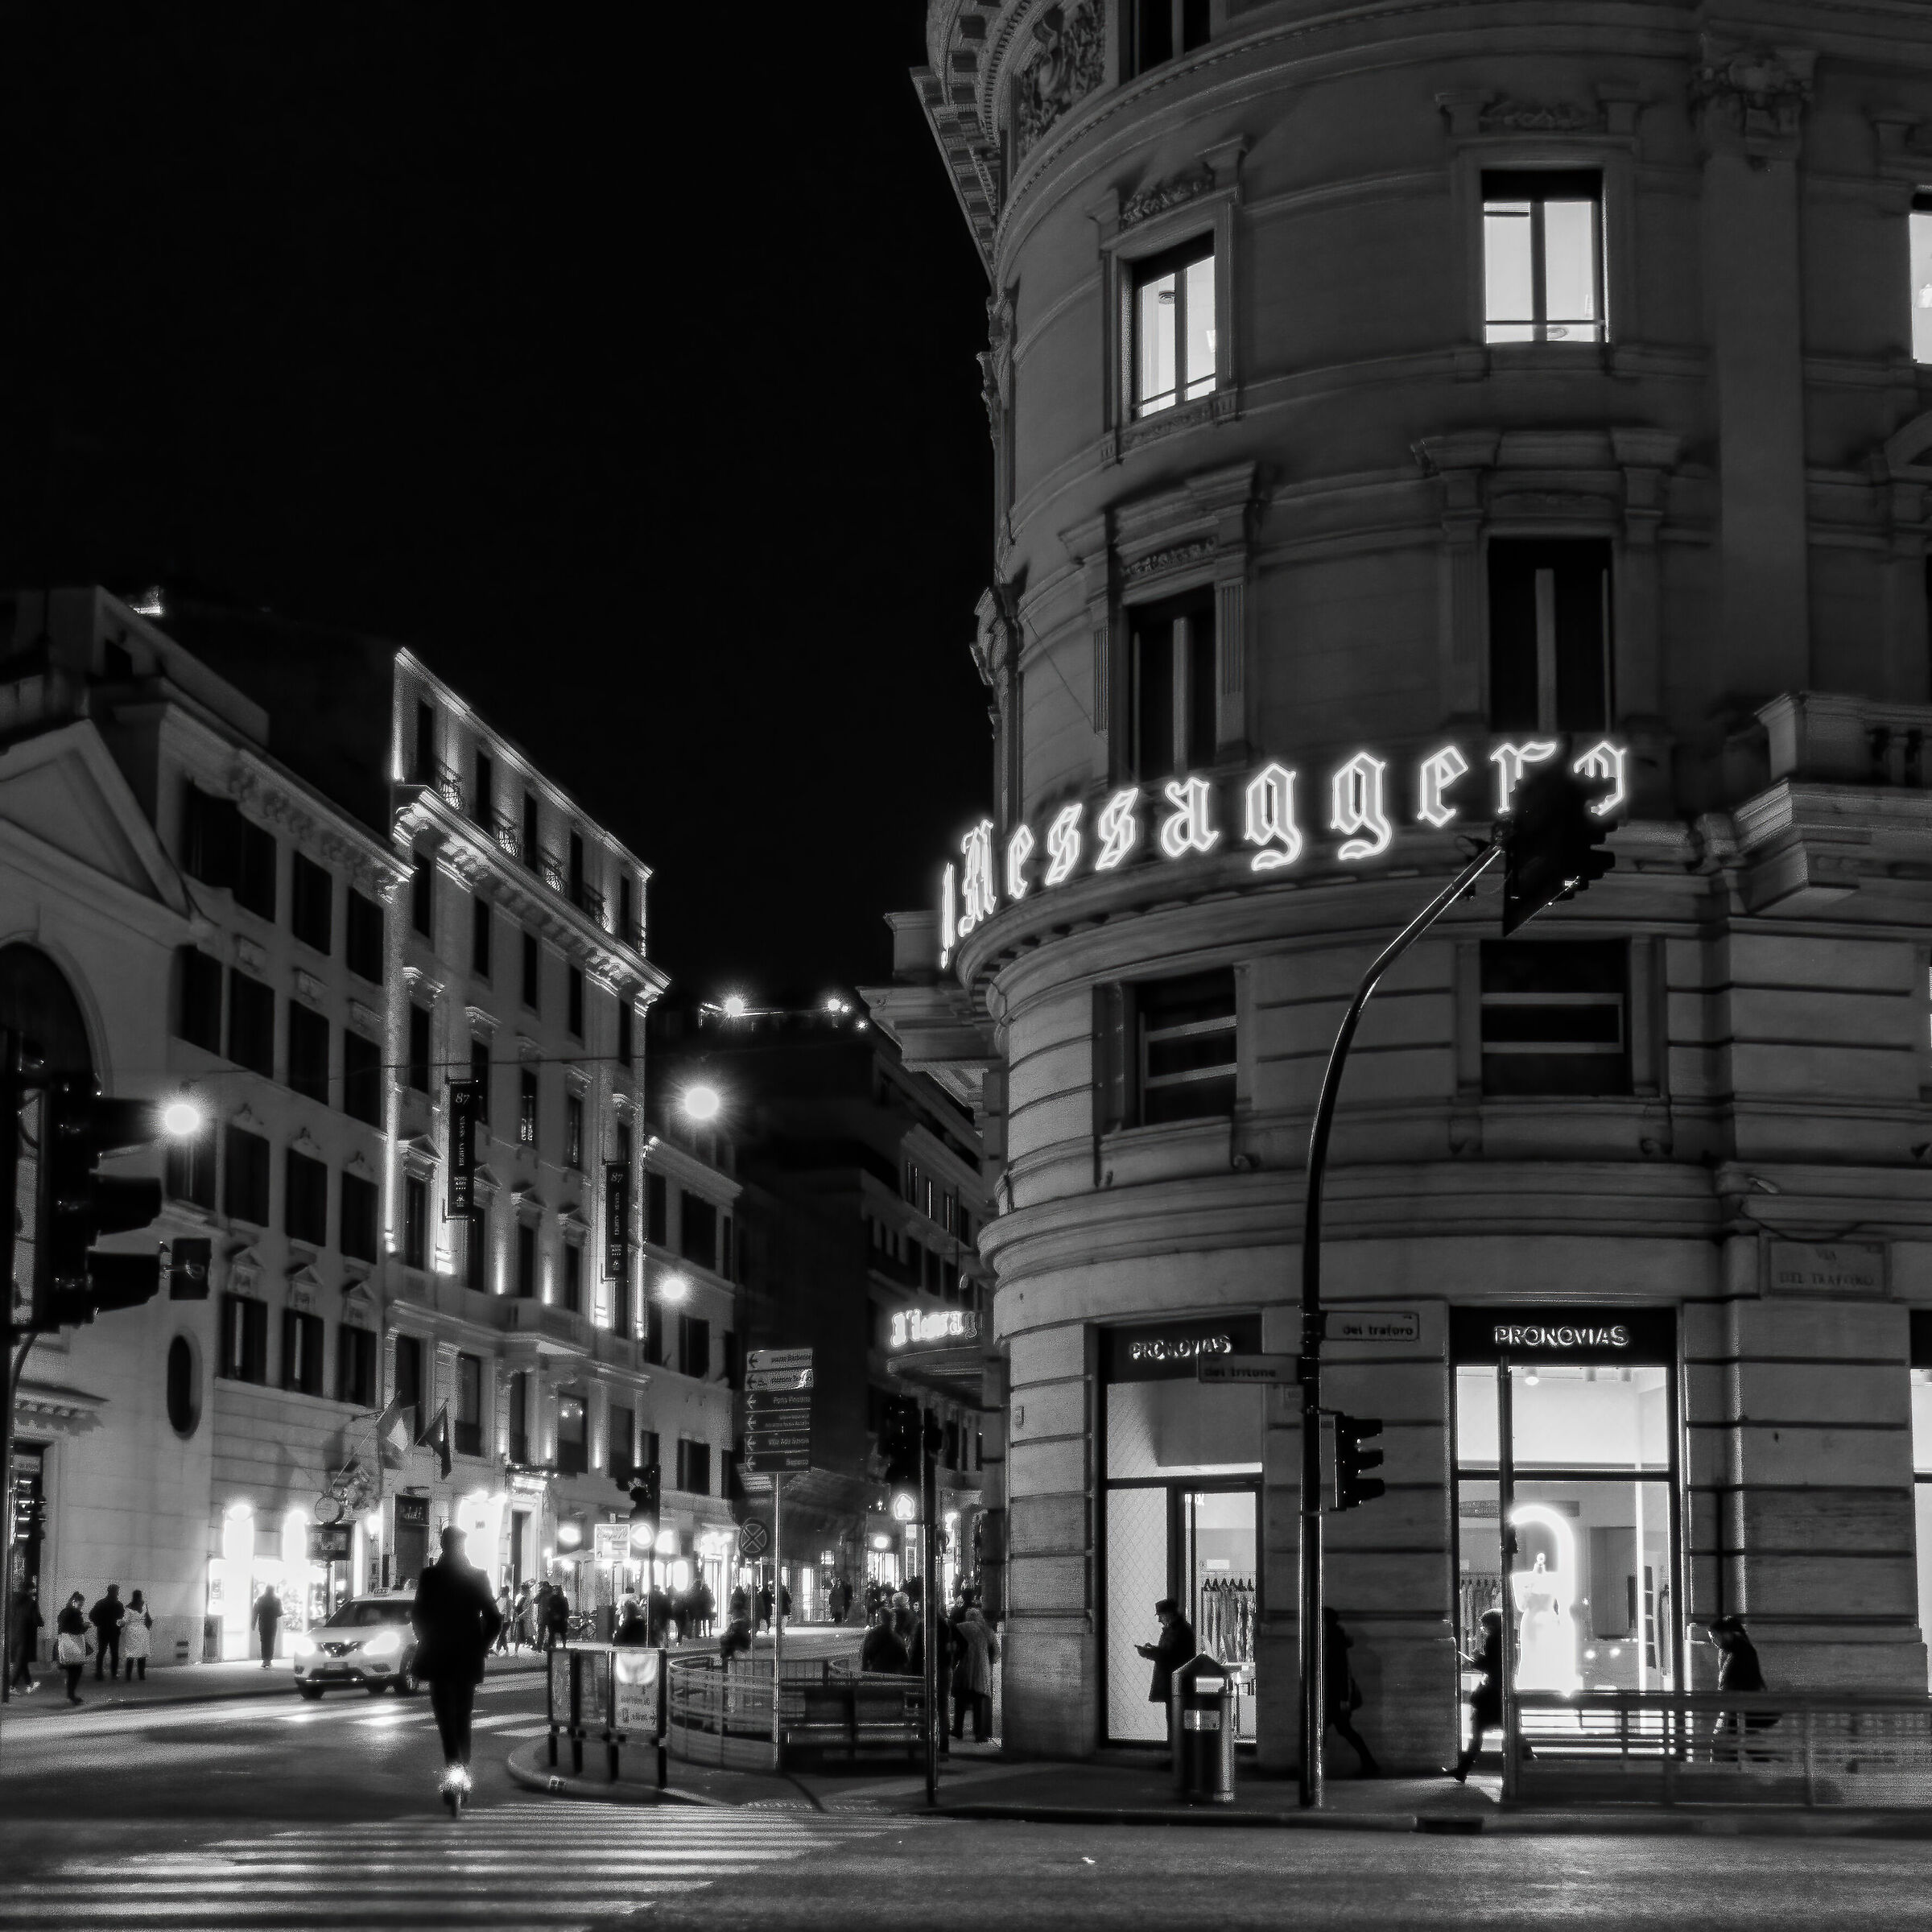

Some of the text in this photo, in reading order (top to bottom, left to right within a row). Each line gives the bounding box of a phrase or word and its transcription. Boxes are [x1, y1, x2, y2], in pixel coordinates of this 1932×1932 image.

[455, 1092, 469, 1104] 87
[610, 1172, 624, 1183] 87
[1492, 1325, 1630, 1348] PRONOVIAS
